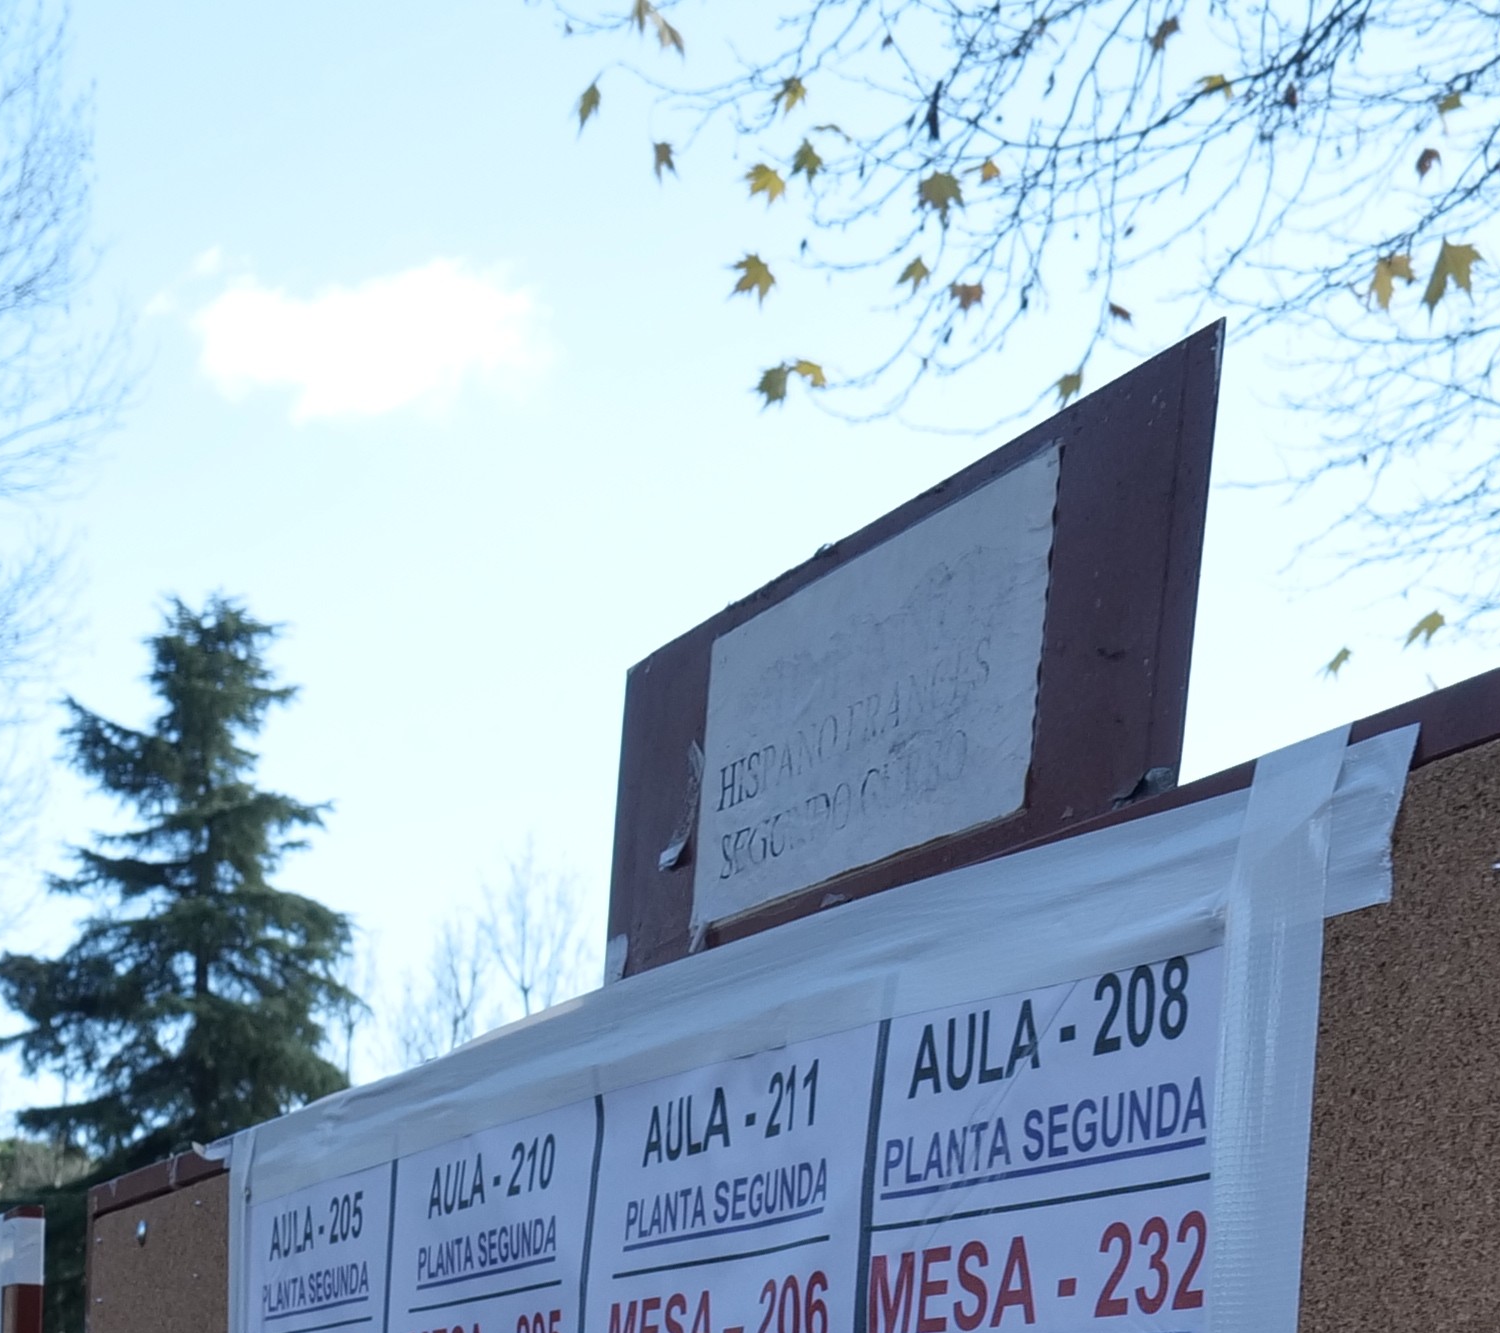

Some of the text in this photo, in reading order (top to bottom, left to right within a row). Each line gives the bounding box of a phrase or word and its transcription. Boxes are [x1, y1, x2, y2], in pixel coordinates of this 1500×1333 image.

[720, 782, 852, 879] SEGUDO
[908, 999, 1040, 1099] AULA
[1093, 955, 1188, 1056] 208
[642, 1086, 731, 1167] AULA
[765, 1058, 819, 1138] 211
[883, 1076, 1206, 1186] PLANTA SEGUNDA
[428, 1153, 485, 1219] AULA
[507, 1133, 556, 1196] 210
[625, 1158, 827, 1240] PLANTA SEGUNDA
[269, 1206, 314, 1262] AULA
[329, 1191, 363, 1244] 205
[418, 1215, 556, 1281] PLANTA SEGUNDA
[1094, 1210, 1207, 1318] 232
[263, 1261, 369, 1313] PLANTA SEGUNDA
